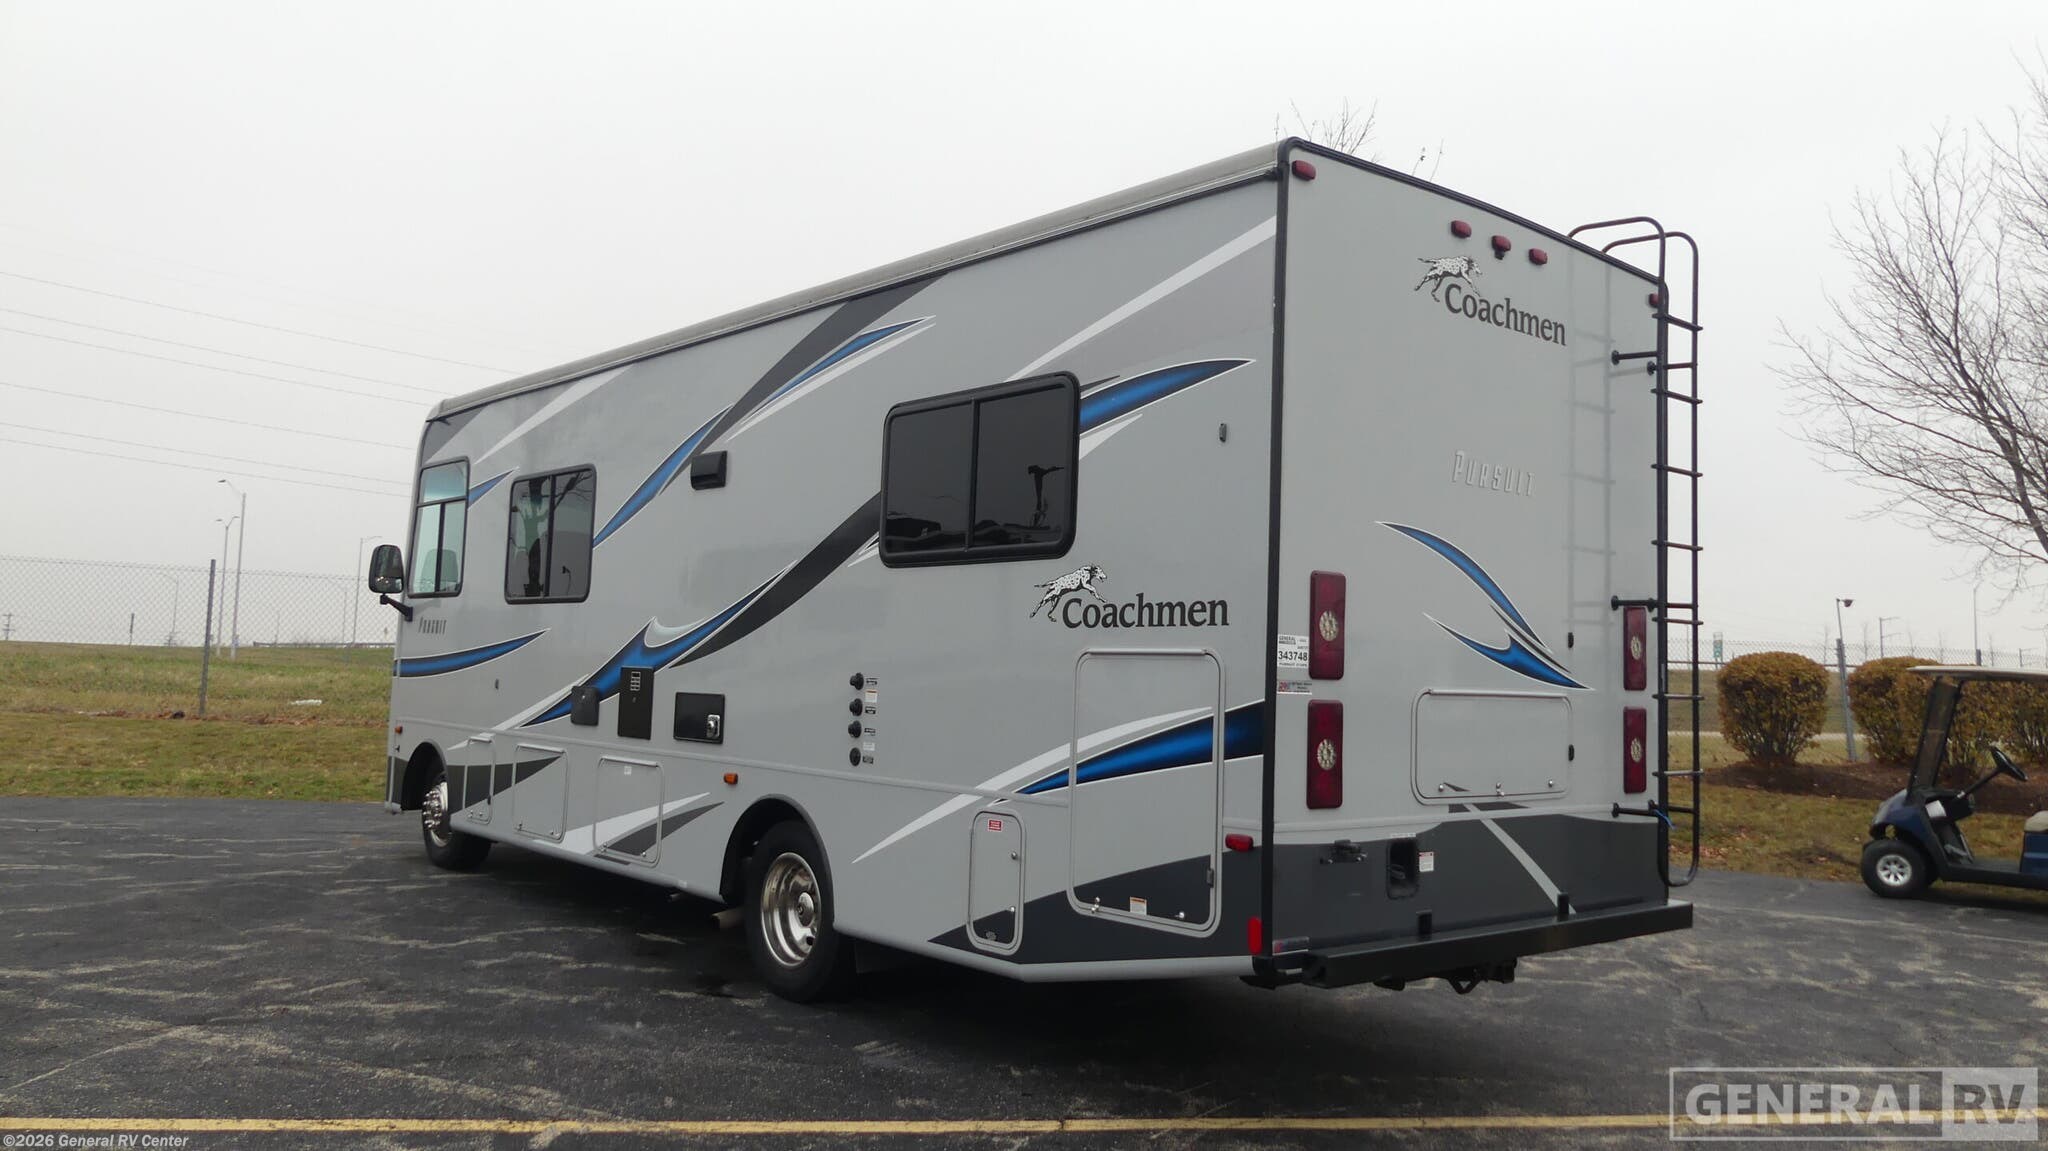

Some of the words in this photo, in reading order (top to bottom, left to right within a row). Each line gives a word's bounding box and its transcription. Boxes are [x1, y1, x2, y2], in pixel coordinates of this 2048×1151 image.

[1445, 283, 1566, 346] Coachmen
[1062, 592, 1229, 629] Coachmen
[1278, 650, 1308, 661] 343748
